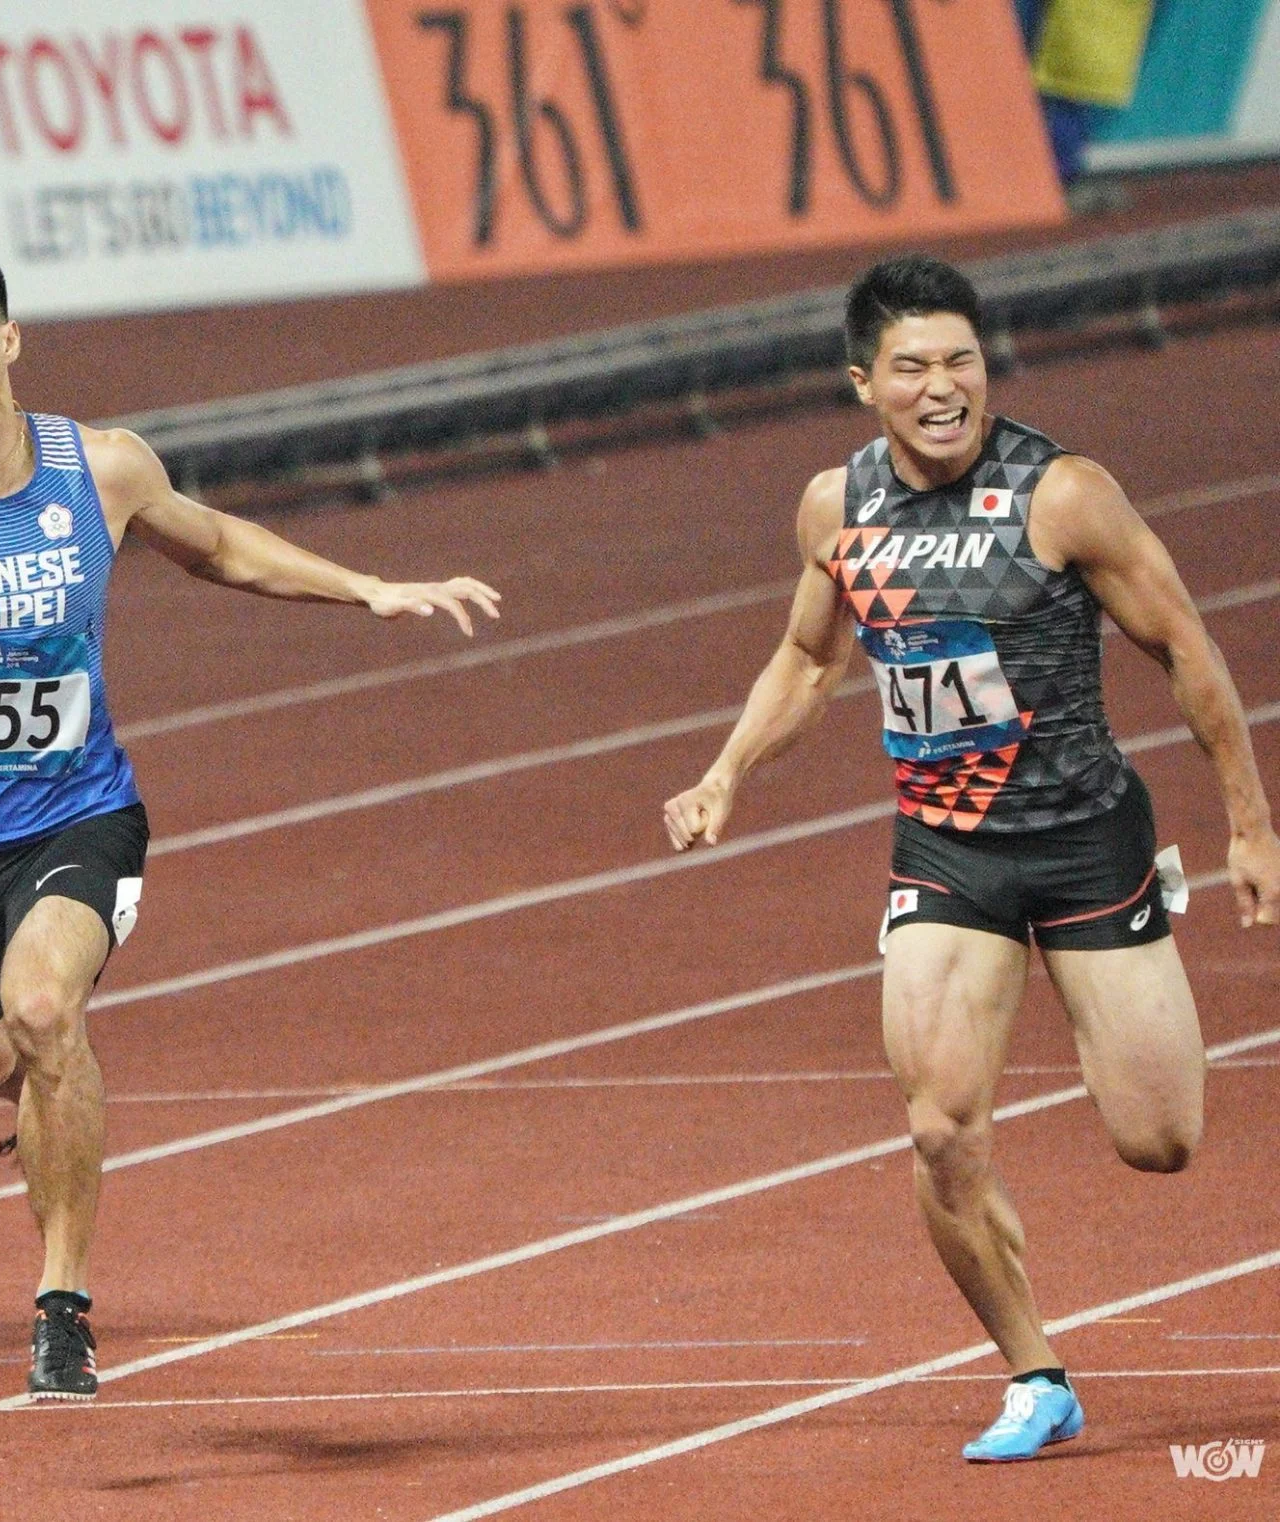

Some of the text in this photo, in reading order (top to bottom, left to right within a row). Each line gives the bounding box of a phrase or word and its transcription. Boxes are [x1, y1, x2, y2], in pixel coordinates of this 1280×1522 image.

[190, 161, 353, 248] BEYOND
[846, 533, 996, 570] JAPAN
[888, 661, 988, 733] 471
[932, 739, 976, 755] PERTAMINA
